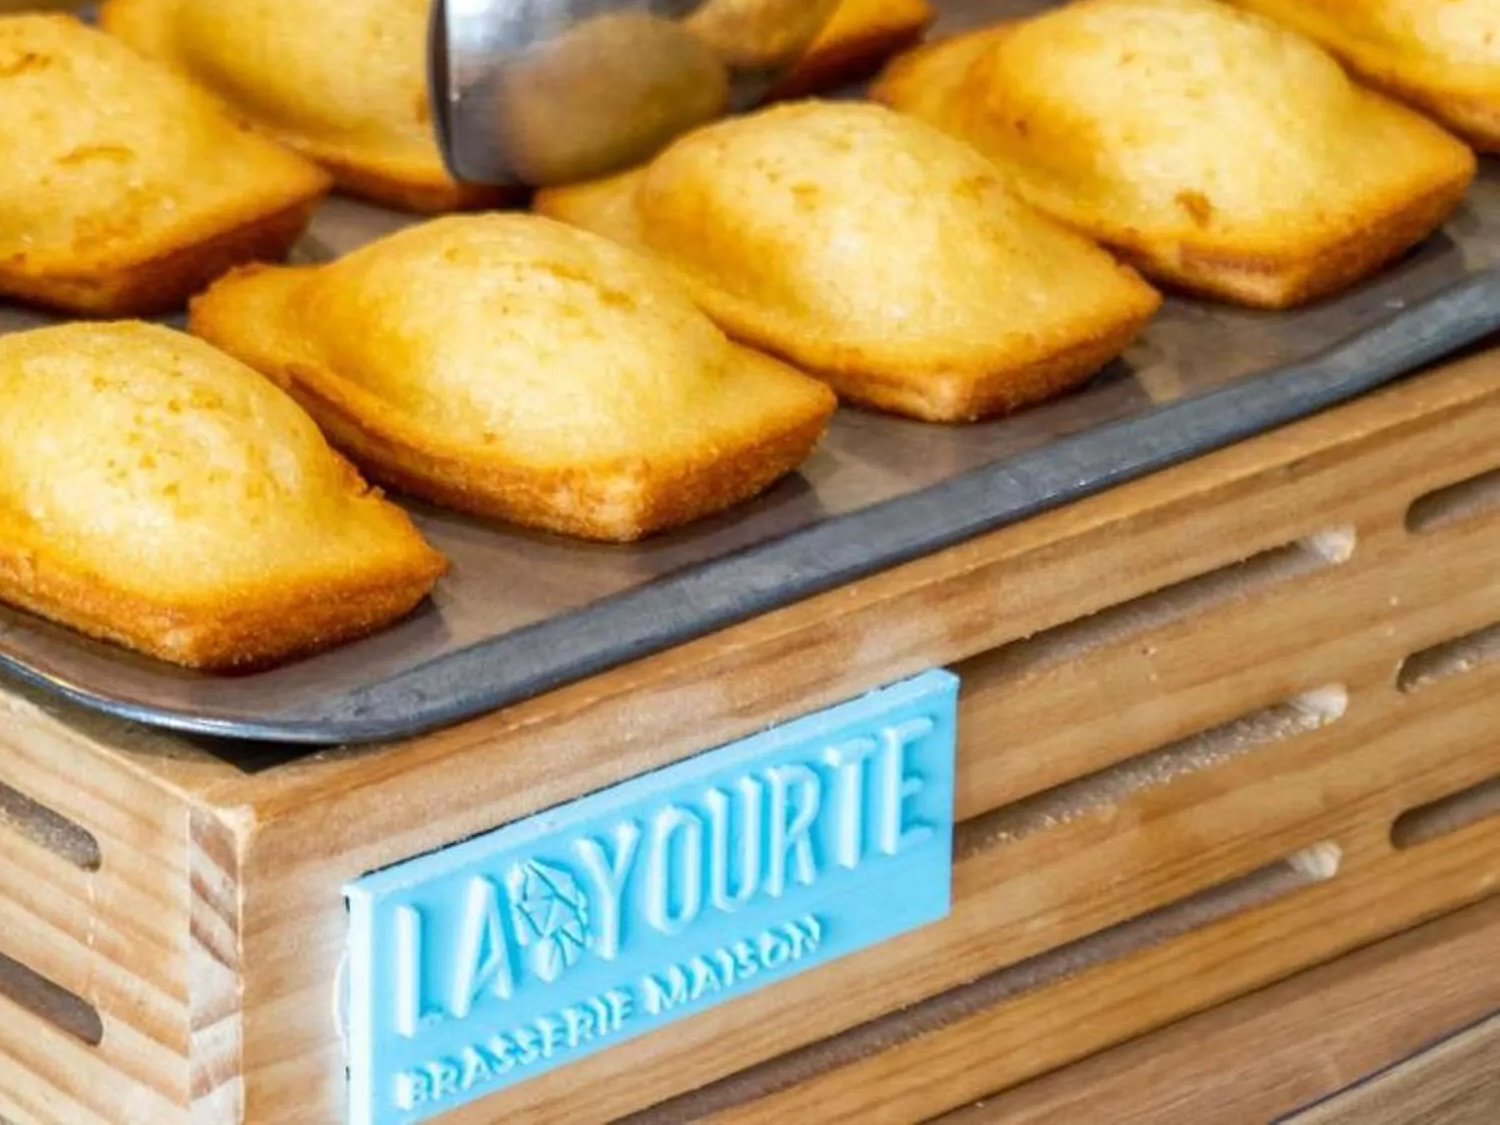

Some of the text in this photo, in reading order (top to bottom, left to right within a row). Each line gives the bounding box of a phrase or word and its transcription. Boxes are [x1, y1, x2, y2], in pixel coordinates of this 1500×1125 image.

[393, 713, 937, 1039] LA YOURTE
[394, 913, 823, 1112] BRASSERIE MAISON
